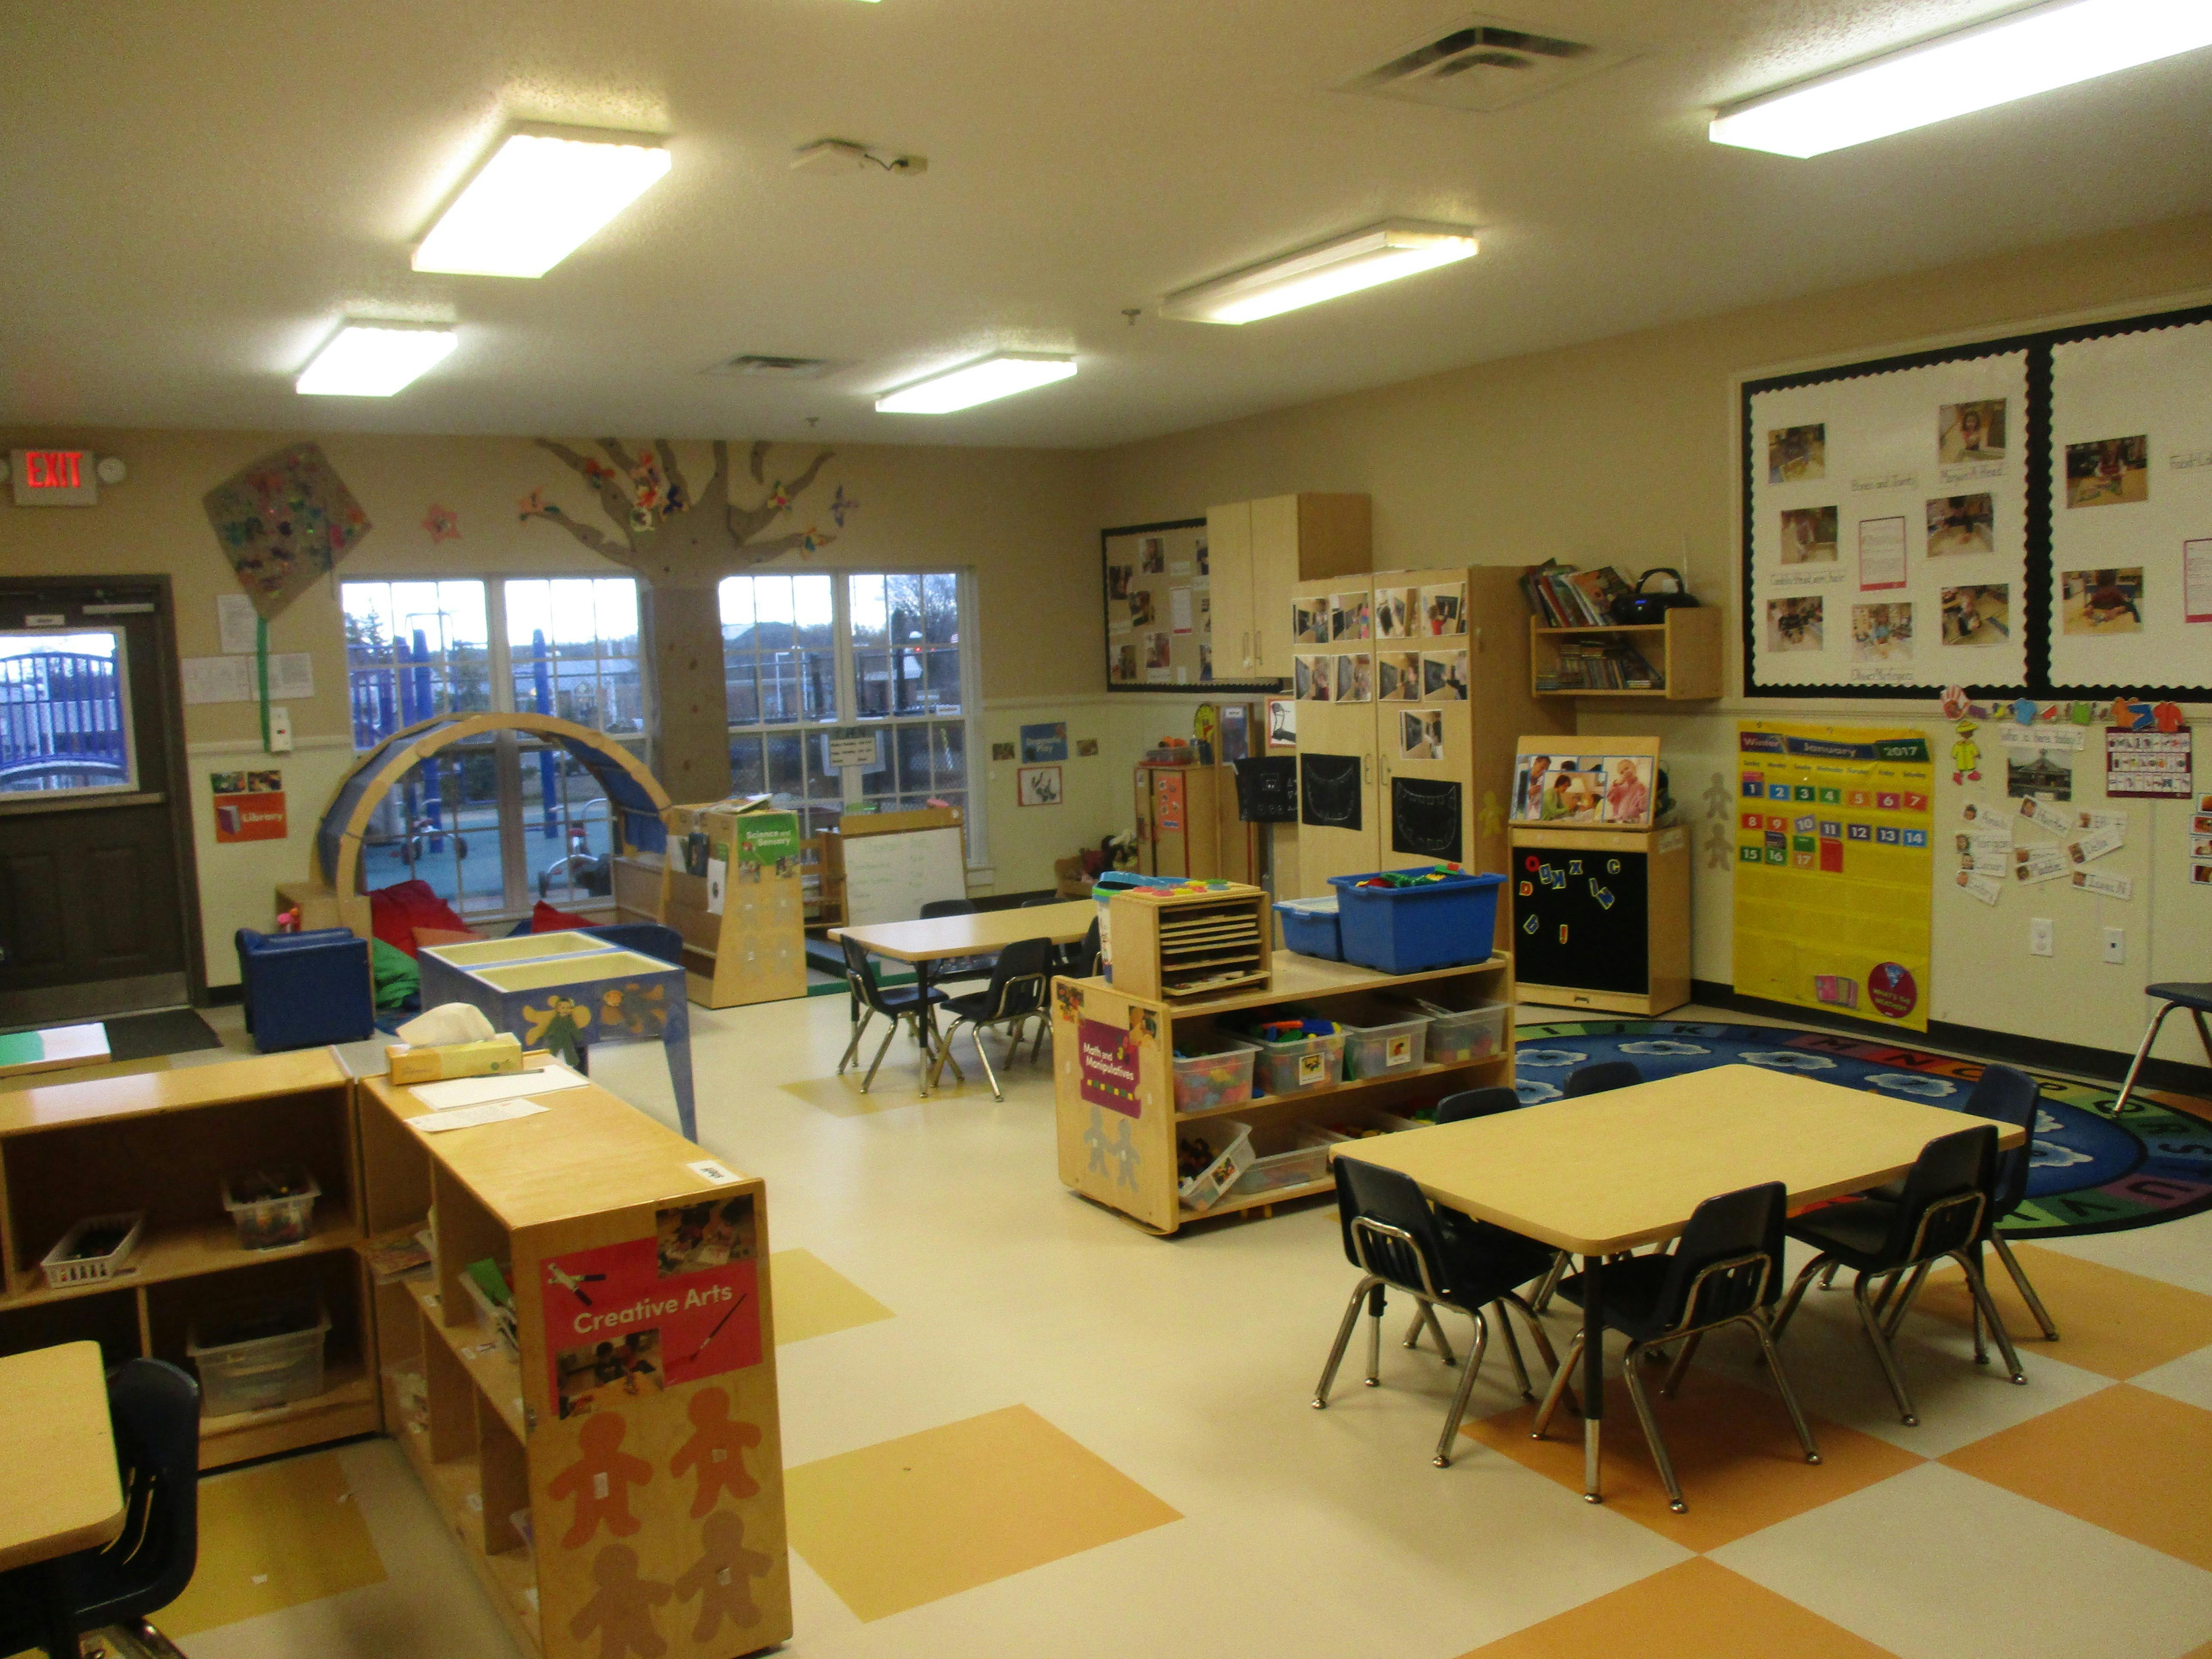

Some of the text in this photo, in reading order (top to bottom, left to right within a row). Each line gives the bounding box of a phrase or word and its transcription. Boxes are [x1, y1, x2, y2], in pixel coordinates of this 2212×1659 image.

[26, 452, 82, 488] EXIT
[1804, 742, 1856, 757] January
[1884, 746, 1918, 757] 2017
[1750, 784, 1920, 806] 1 2 3 4 5 6 7
[243, 811, 283, 823] Library
[746, 830, 778, 839] Science
[1748, 816, 1923, 843] 8 9 10 11 12 13 14
[757, 838, 791, 846] Sensory
[1743, 849, 1811, 865] 15 16 17
[1569, 860, 1583, 875] X
[1607, 859, 1621, 874] C
[1519, 881, 1534, 896] D
[1083, 1042, 1113, 1062] Math and
[1086, 1055, 1134, 1081] Manipulatives
[574, 1284, 732, 1333] Creative Arts
